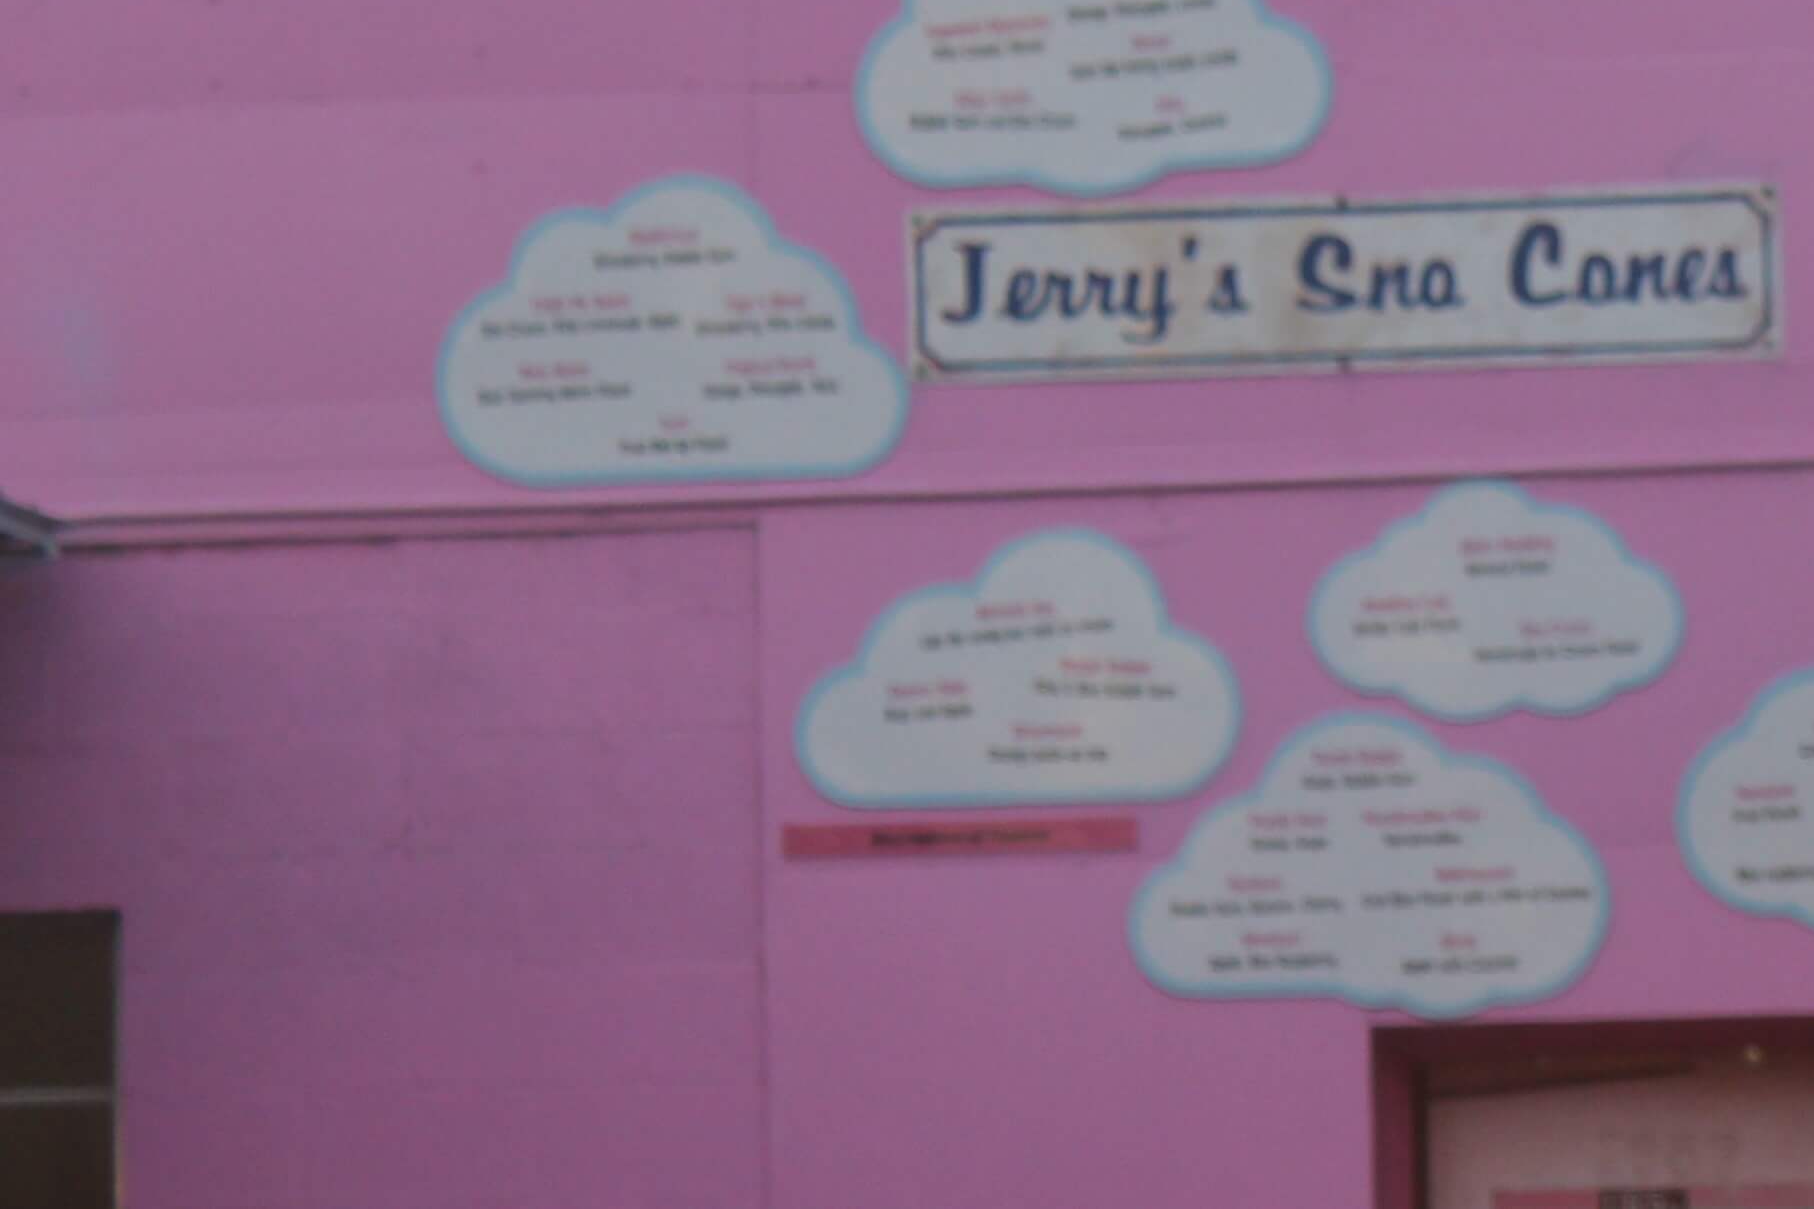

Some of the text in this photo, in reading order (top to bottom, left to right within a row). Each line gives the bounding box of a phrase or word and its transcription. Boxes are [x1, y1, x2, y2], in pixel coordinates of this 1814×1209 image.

[940, 236, 1248, 345] Jerry's
[1294, 231, 1466, 315] Sno
[1506, 220, 1749, 308] Cones
